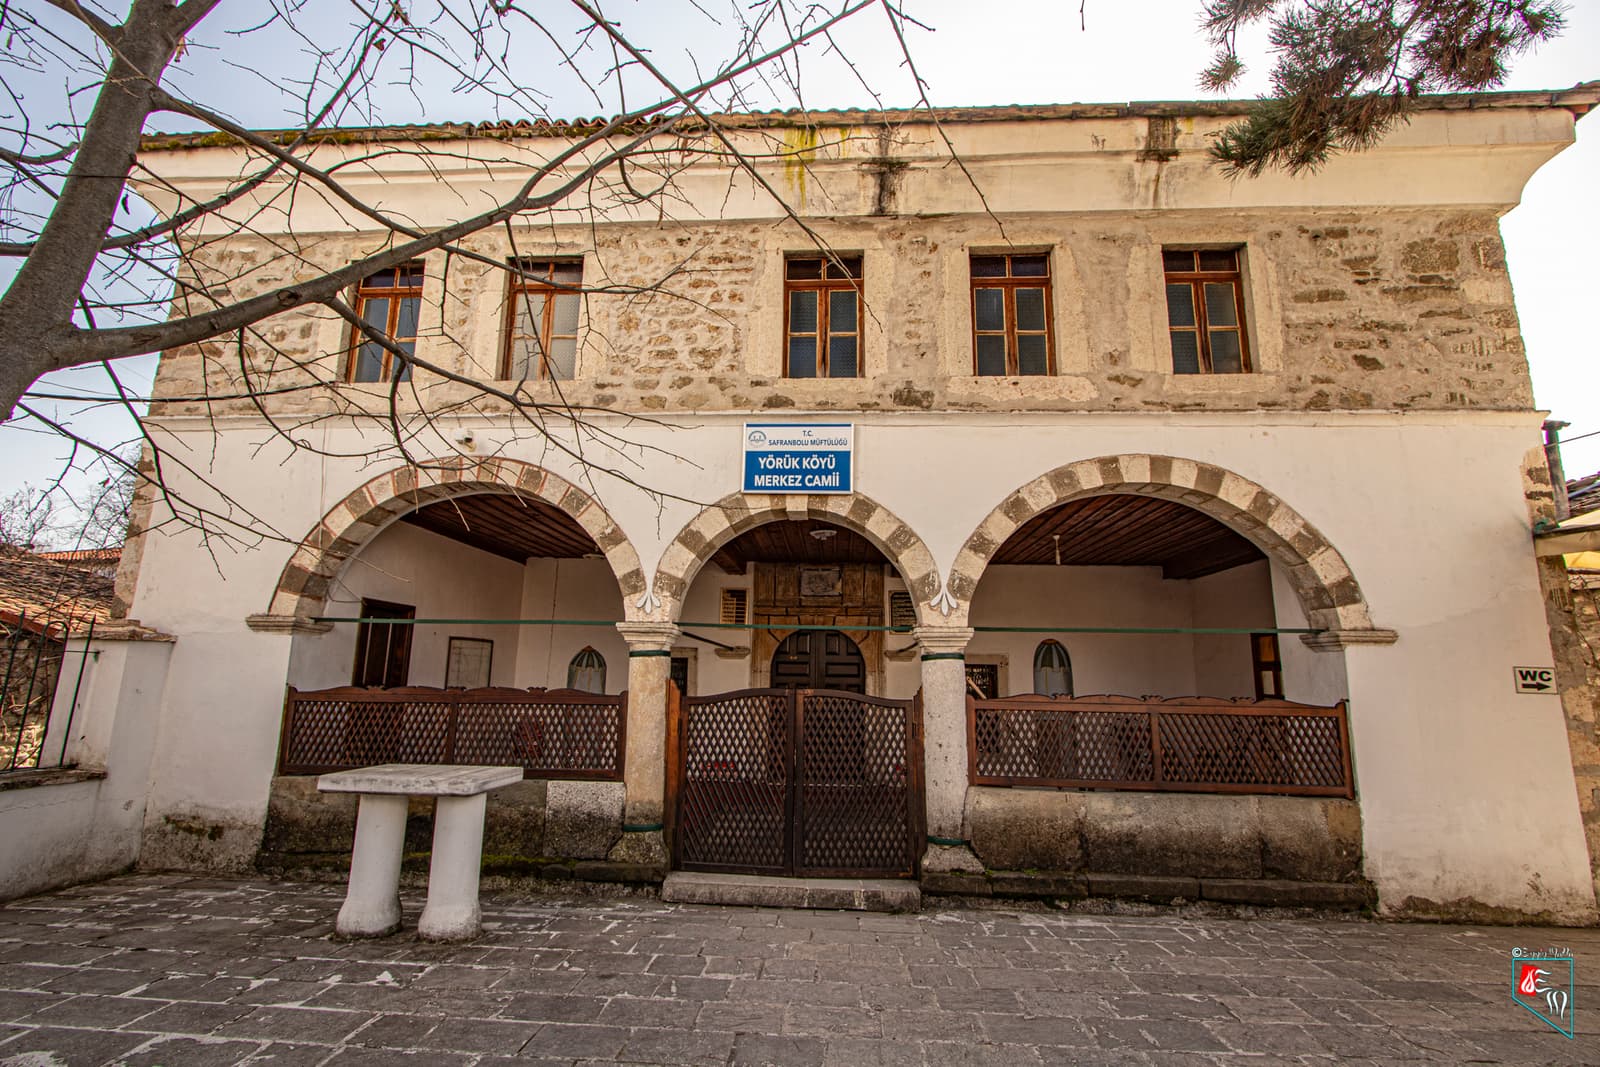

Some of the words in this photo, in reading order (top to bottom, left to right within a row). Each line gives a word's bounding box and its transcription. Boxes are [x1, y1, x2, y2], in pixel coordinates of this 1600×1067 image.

[810, 437, 848, 446] MÜFTÜLÜĞÜ
[758, 454, 800, 469] YÖRÜK
[802, 454, 836, 469] KÖYÜ
[754, 474, 802, 487] MERKEZ
[804, 471, 840, 487] CAMİİ
[1518, 669, 1553, 682] WC
